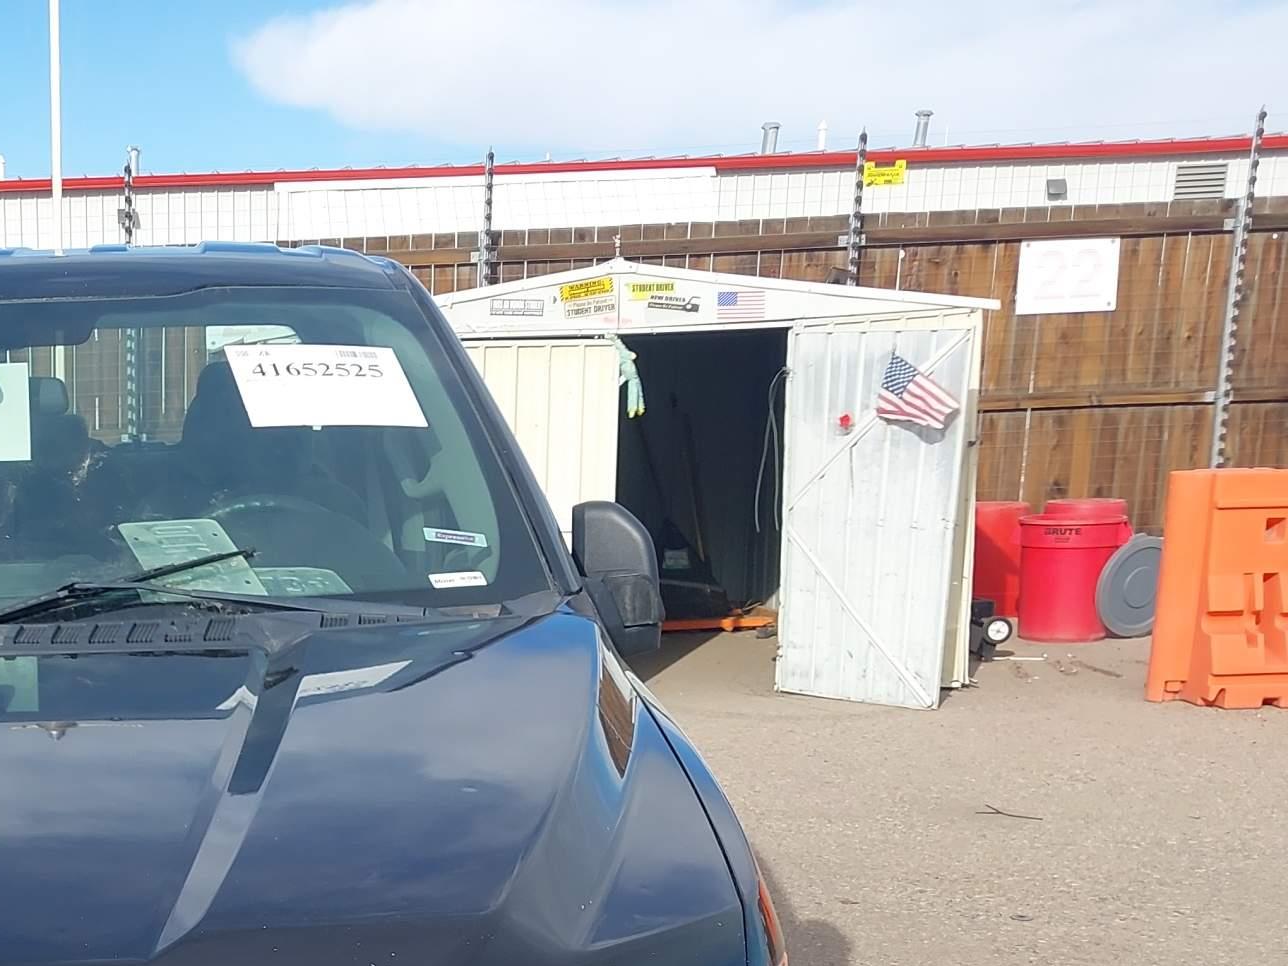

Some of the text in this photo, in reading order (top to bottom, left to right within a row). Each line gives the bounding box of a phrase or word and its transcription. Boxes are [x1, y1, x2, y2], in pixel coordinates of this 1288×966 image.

[567, 303, 616, 316] STUDENT DRIVER
[252, 362, 384, 377] 41652525
